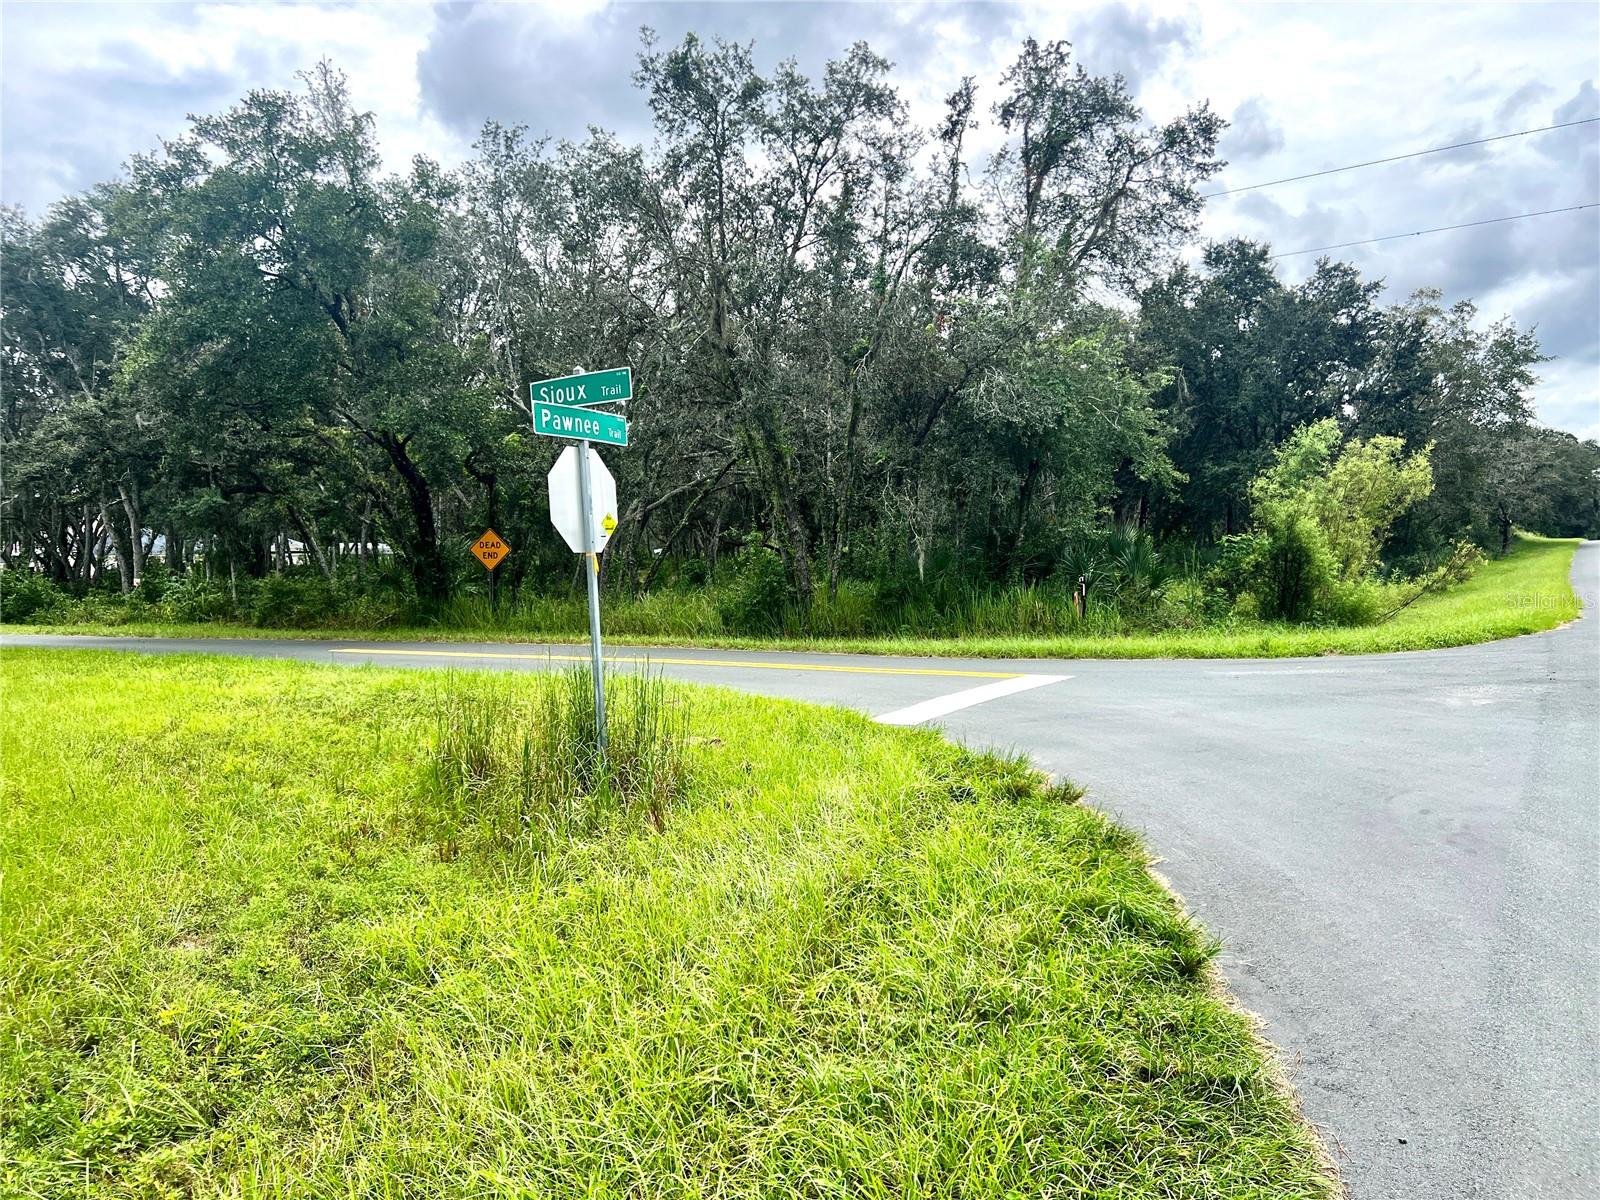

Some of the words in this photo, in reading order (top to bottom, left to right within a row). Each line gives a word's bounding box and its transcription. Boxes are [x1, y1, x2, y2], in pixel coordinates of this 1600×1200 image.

[540, 384, 587, 404] Sioux
[600, 384, 622, 396] Trail
[541, 409, 600, 435] Pawnee
[607, 427, 622, 439] Trail
[480, 541, 501, 549] DEAD
